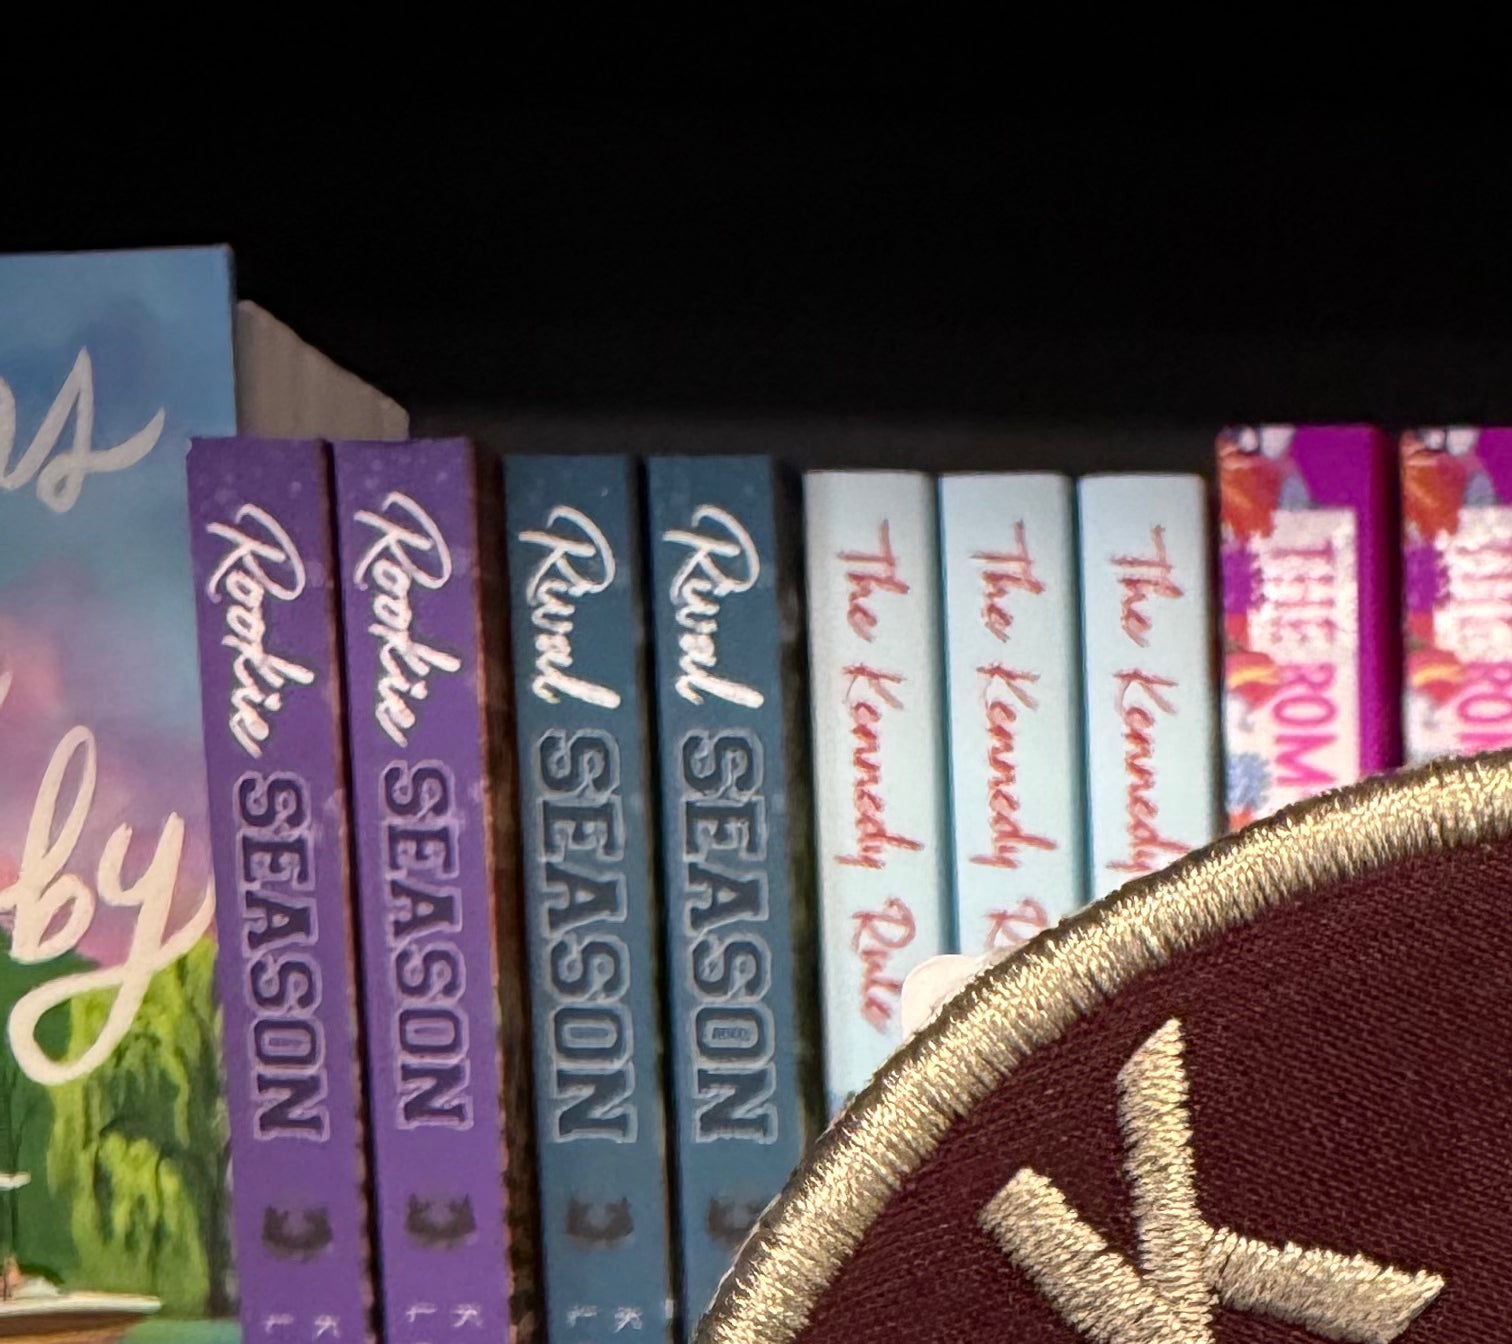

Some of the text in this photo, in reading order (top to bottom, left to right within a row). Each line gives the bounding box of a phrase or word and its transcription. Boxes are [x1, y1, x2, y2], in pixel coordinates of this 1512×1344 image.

[207, 504, 332, 1143] Rookie SEASON
[354, 492, 471, 1131] Rookie SEASON
[519, 506, 639, 1143] Rival SEASON
[664, 504, 779, 1143] Rival SEASON
[834, 519, 923, 1035] The Kennedy Rule
[969, 661, 1057, 870] Kennedy
[970, 519, 1045, 643] The
[1106, 525, 1194, 872] The Kennedy
[1269, 539, 1336, 644] THE
